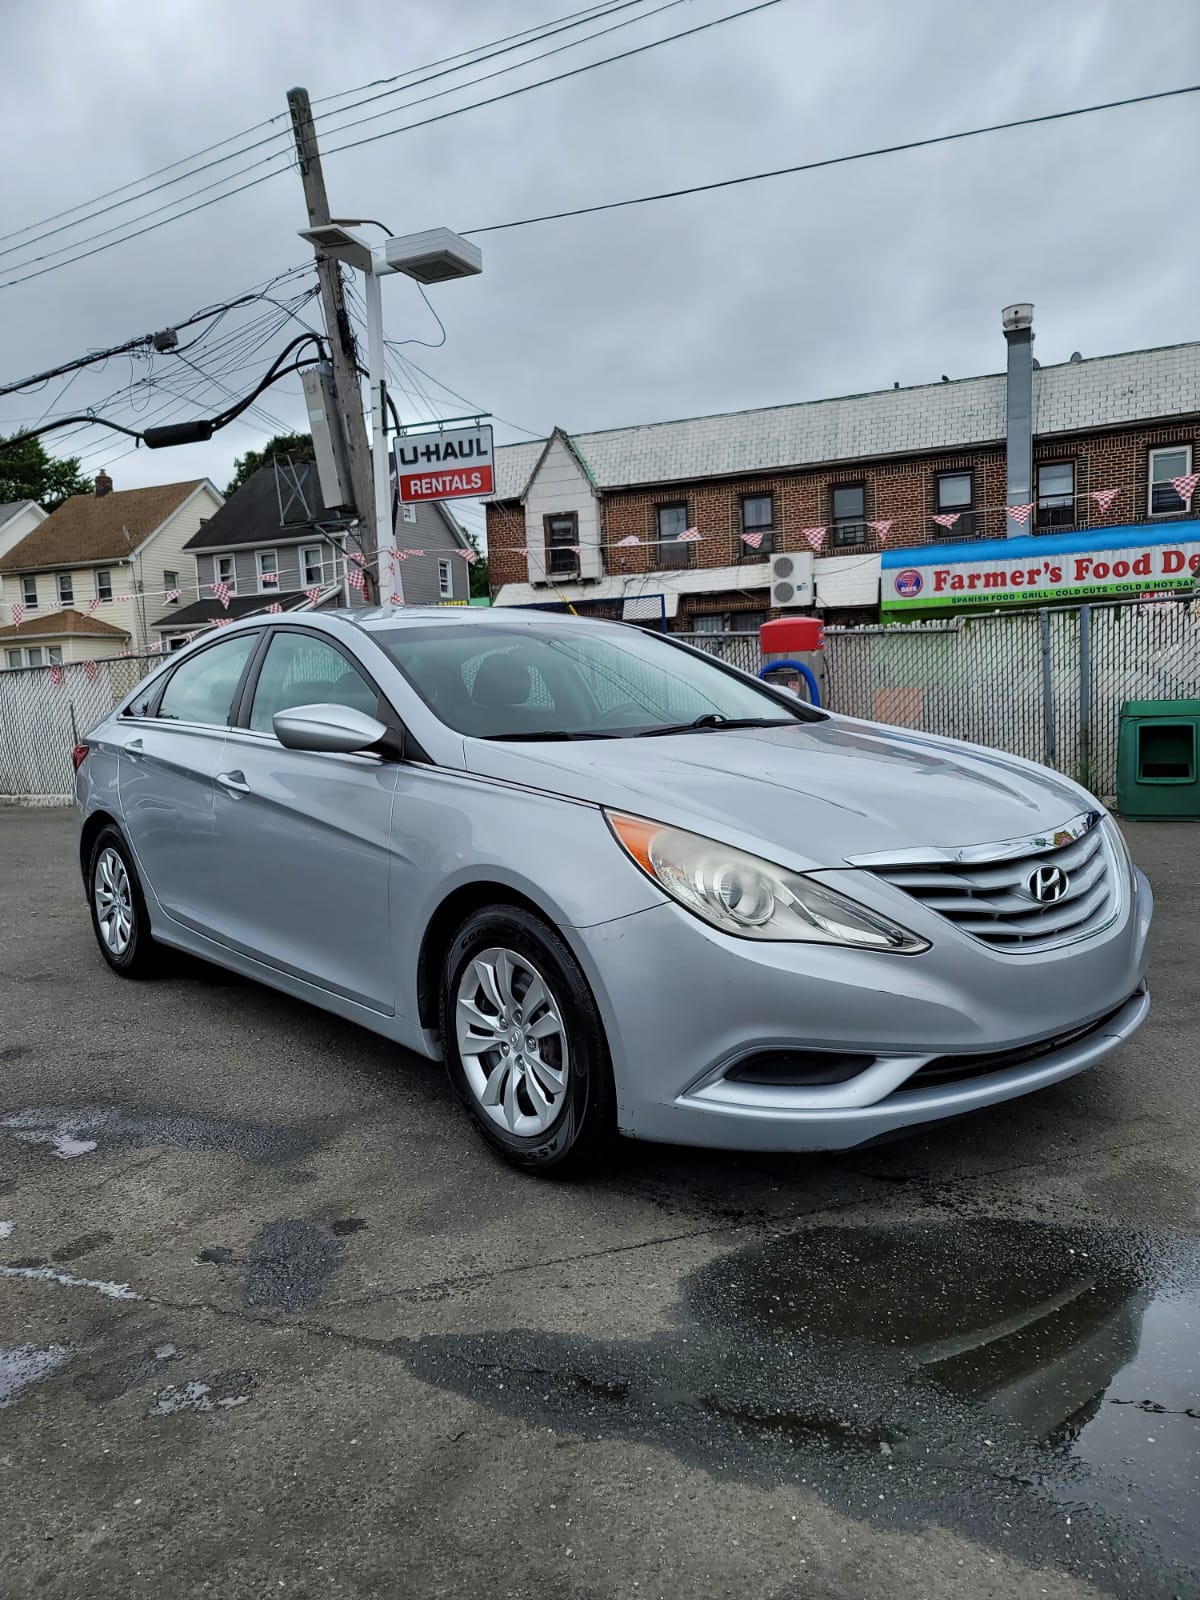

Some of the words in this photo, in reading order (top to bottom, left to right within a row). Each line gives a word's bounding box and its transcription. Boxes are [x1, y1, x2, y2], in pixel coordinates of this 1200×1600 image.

[399, 438, 488, 465] U-HAUL
[410, 473, 482, 495] RENTALS
[934, 562, 1062, 592] Farmer's
[1074, 553, 1152, 581] Food
[951, 596, 989, 604] SPANISH
[990, 593, 1015, 602] FOOD
[1022, 591, 1049, 600] GRILL
[1055, 588, 1081, 596] COLD
[1082, 586, 1108, 594] CUTS
[1115, 583, 1142, 591] COLD
[1144, 582, 1151, 590] &
[1153, 581, 1174, 589] HOT
